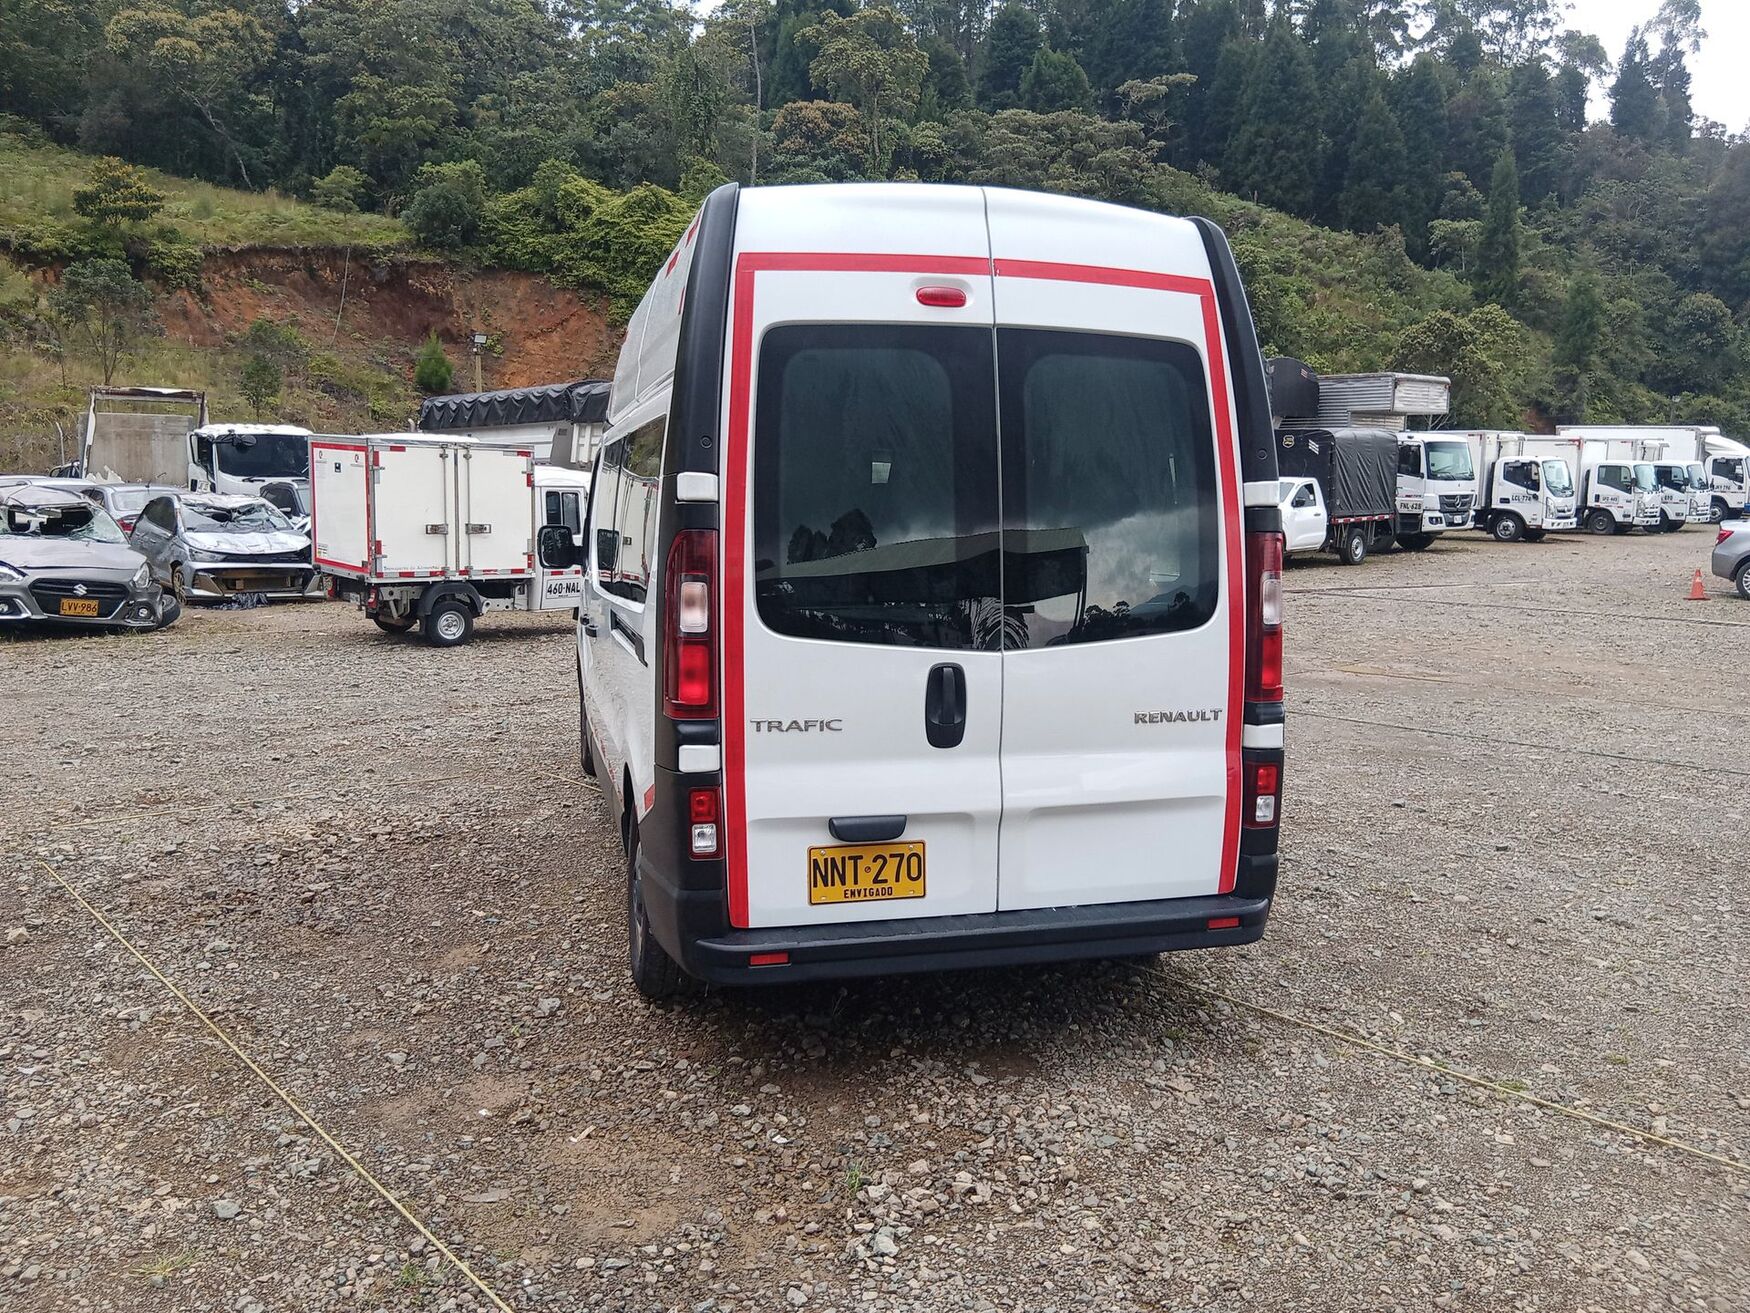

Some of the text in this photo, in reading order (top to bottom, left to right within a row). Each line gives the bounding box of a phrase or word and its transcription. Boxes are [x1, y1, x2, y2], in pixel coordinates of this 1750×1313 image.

[1134, 708, 1223, 724] RENAULT
[750, 719, 843, 732] TRAFIC
[844, 886, 893, 899] ENVIGADO
